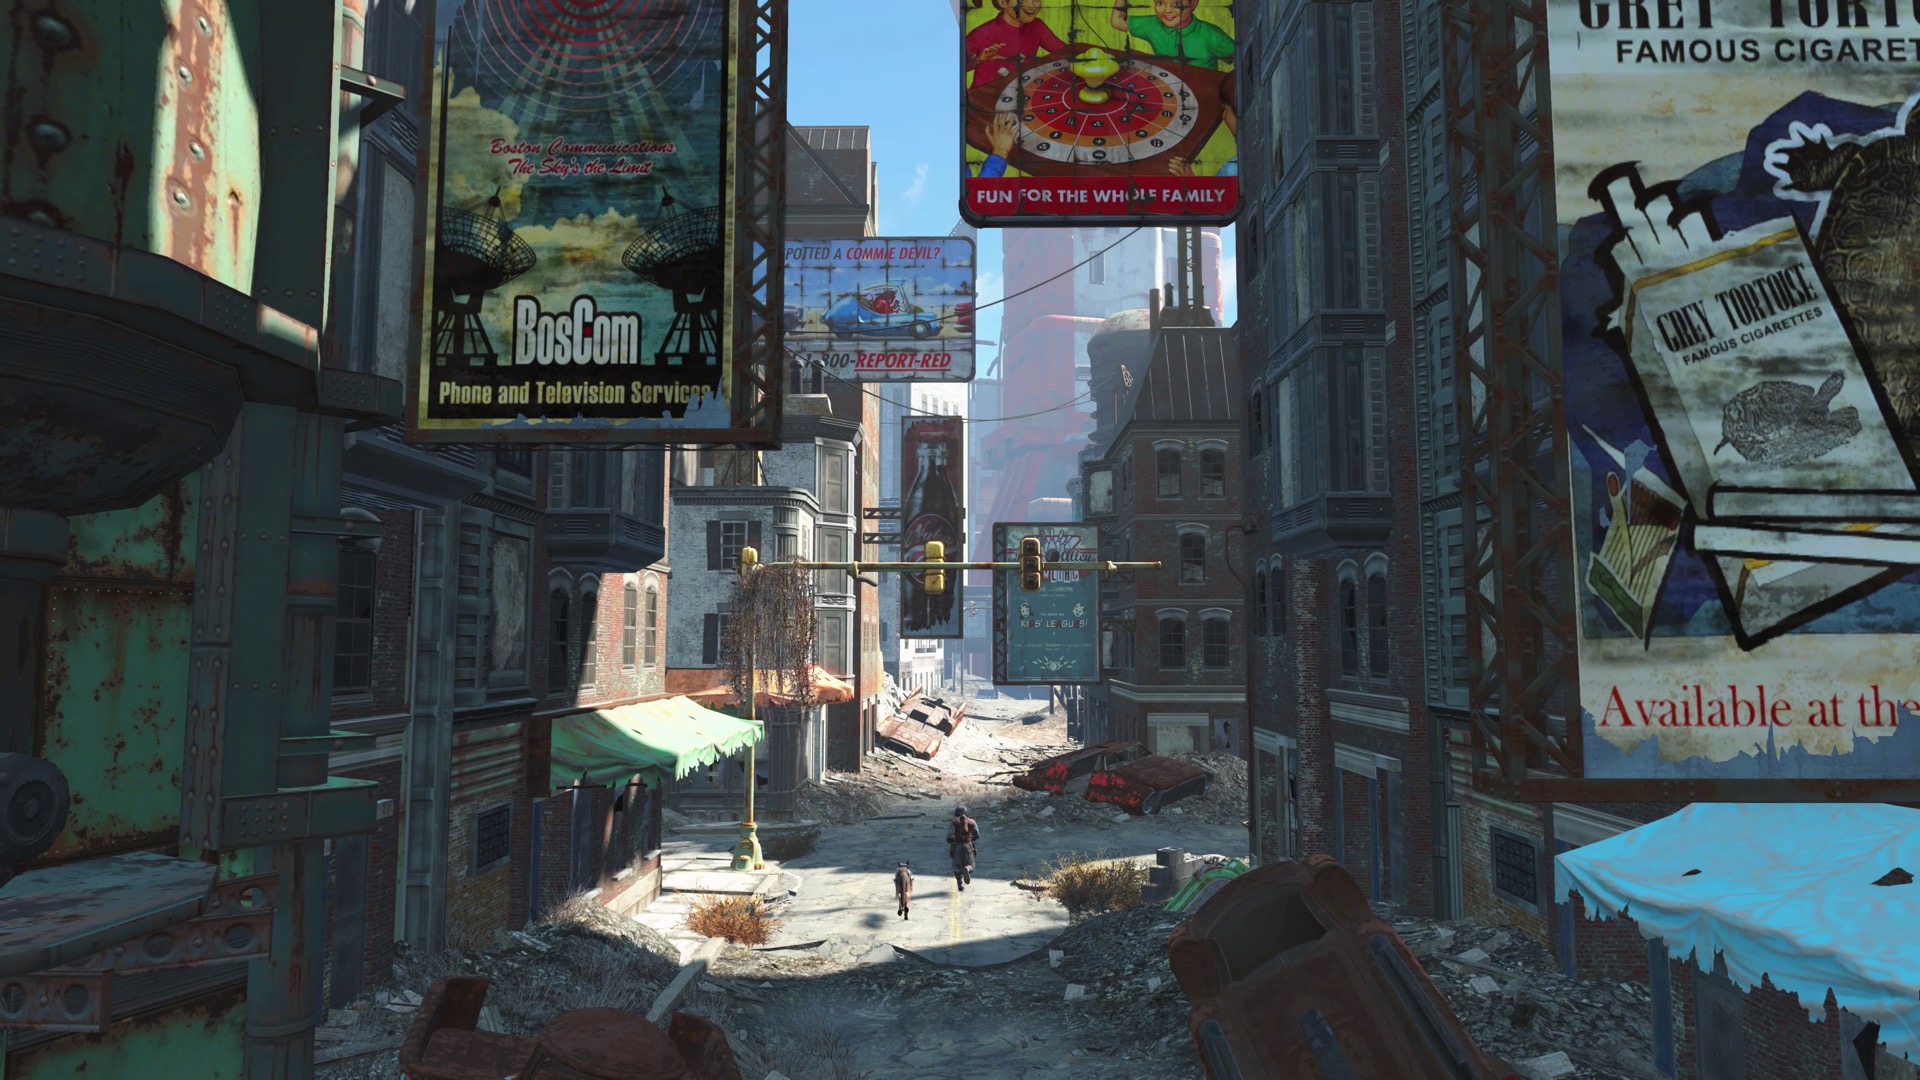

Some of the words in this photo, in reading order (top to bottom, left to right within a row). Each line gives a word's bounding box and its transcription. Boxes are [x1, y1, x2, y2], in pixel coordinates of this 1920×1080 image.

[1616, 39, 1761, 63] FAMOUS
[490, 138, 542, 154] Boston
[547, 136, 676, 156] Communications
[508, 158, 535, 175] The
[538, 158, 580, 179] Sky's
[583, 159, 606, 175] the
[609, 157, 653, 176] Limit
[976, 190, 1013, 204] FUN
[1020, 188, 1053, 202] FOR
[1057, 188, 1089, 203] THE
[1092, 188, 1158, 203] WHOLE
[1162, 188, 1226, 203] FAMILY
[784, 246, 831, 260] POTTED
[833, 247, 842, 260] A
[846, 247, 897, 260] COMMIE
[899, 247, 941, 260] DEVIL?
[1656, 300, 1716, 353] GREY
[1714, 263, 1818, 330] TORTOISE
[515, 298, 639, 365] BosCom
[1683, 338, 1738, 366] FAMOUS
[1740, 306, 1823, 344] CIGARETTES
[439, 381, 492, 405] Phone
[498, 381, 529, 404] and
[536, 381, 625, 404] Television
[1598, 685, 1792, 728] Available
[1807, 693, 1844, 728] at
